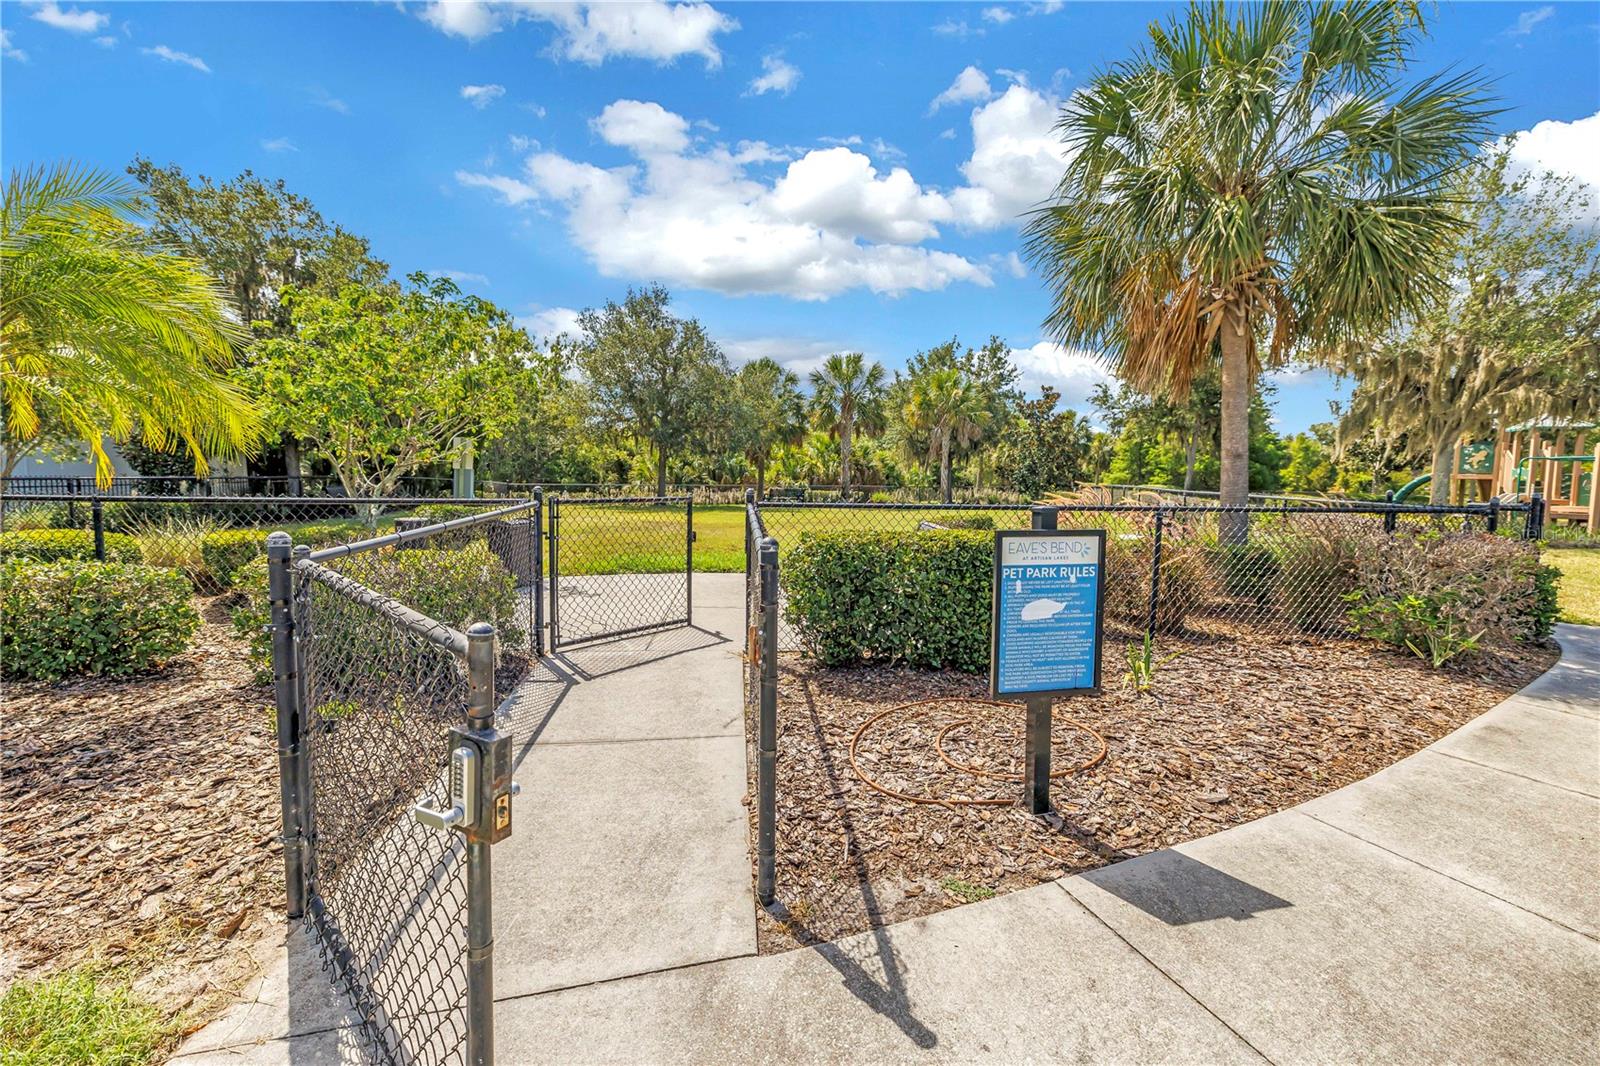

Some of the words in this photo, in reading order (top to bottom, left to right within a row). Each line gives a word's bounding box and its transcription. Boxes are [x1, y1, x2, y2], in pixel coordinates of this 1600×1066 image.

[1008, 541, 1047, 554] EAVE'S
[1050, 541, 1083, 554] BEND
[1003, 567, 1024, 579] PET
[1026, 567, 1057, 578] PARK
[1060, 566, 1096, 578] RULES
